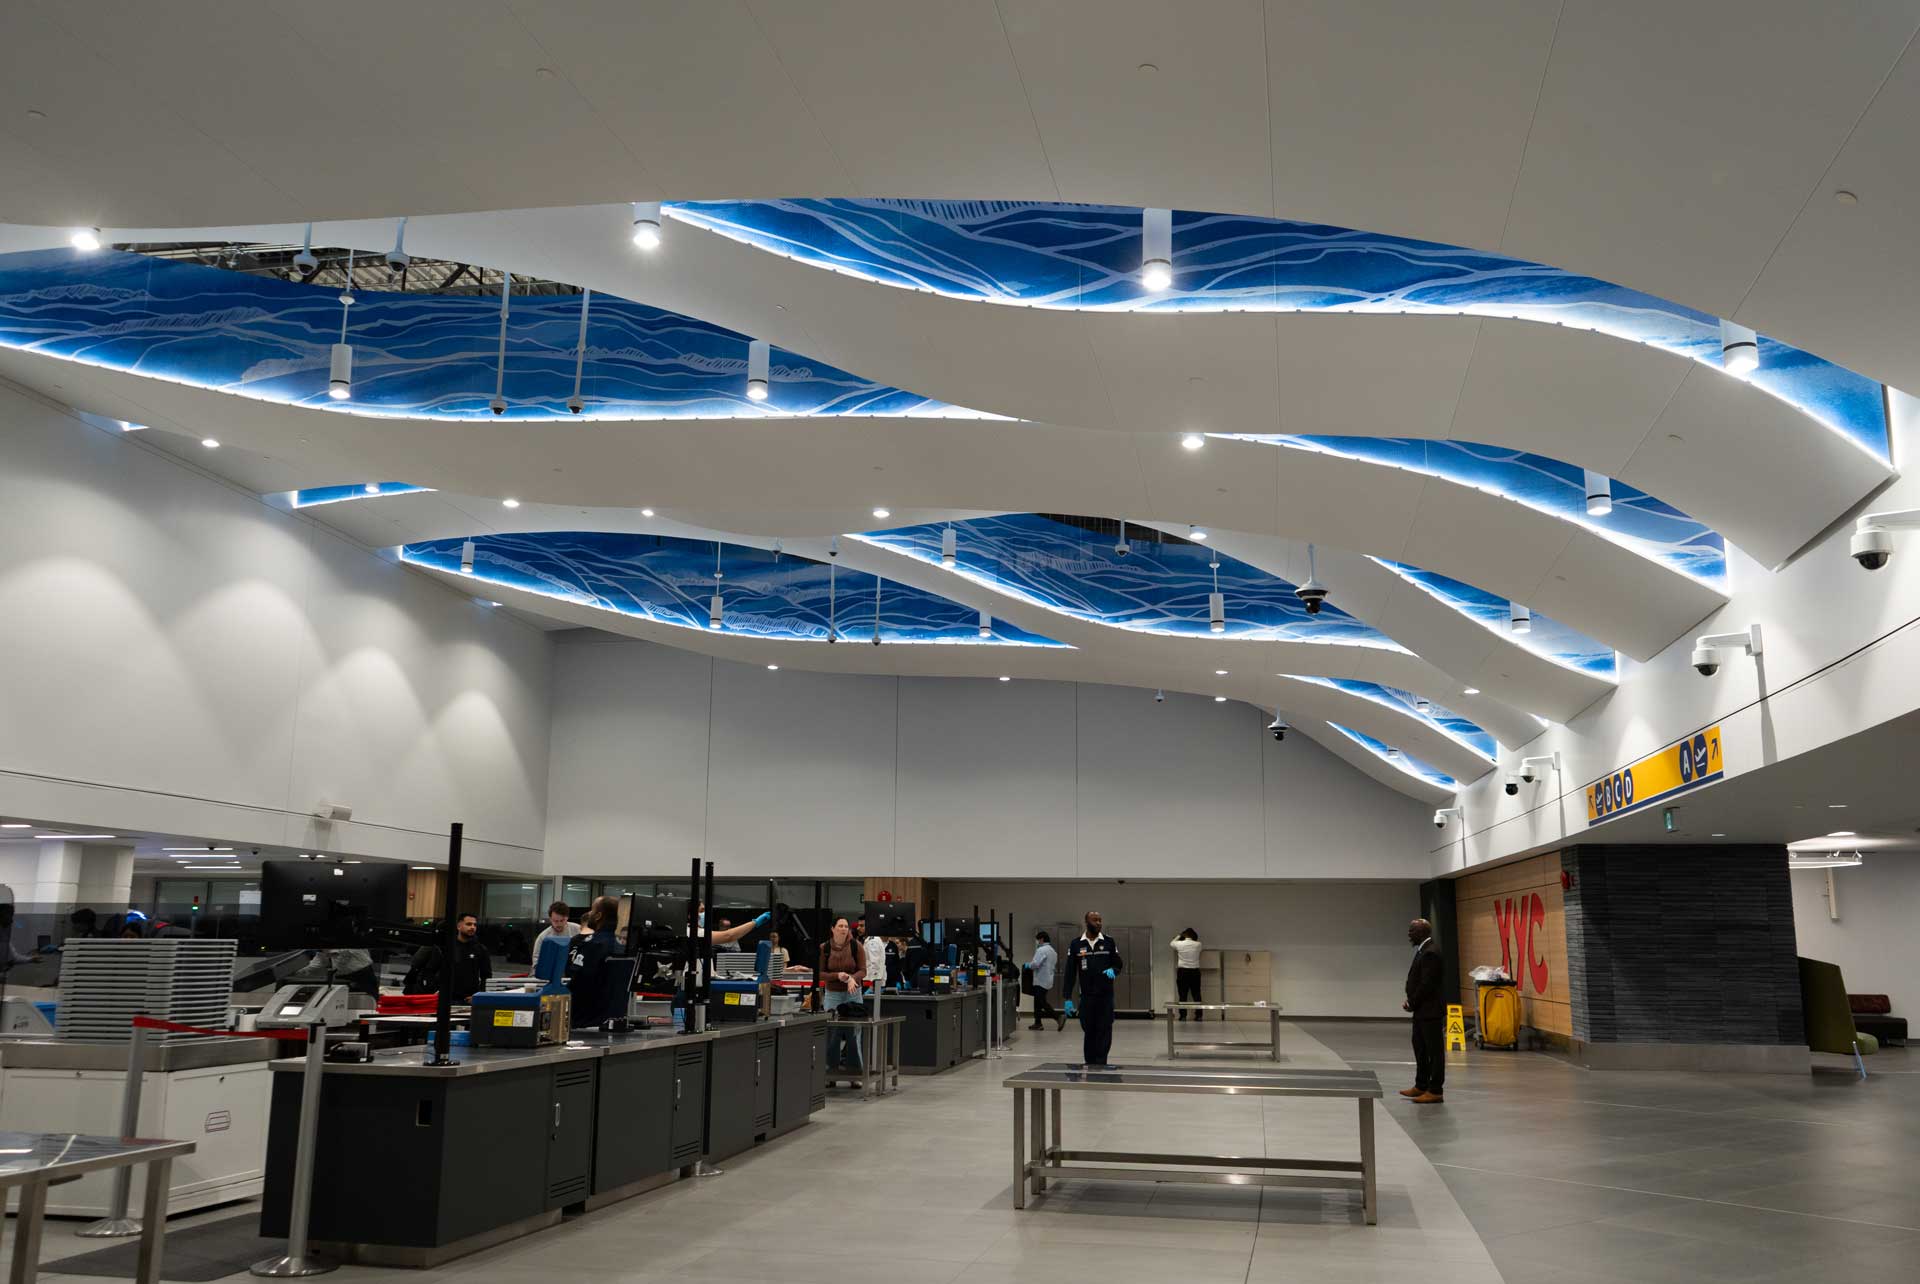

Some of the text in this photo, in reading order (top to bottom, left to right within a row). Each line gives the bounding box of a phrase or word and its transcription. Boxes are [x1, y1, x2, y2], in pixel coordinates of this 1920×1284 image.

[1683, 749, 1691, 776] A
[1605, 775, 1632, 806] B C D
[1494, 892, 1549, 995] YYC
